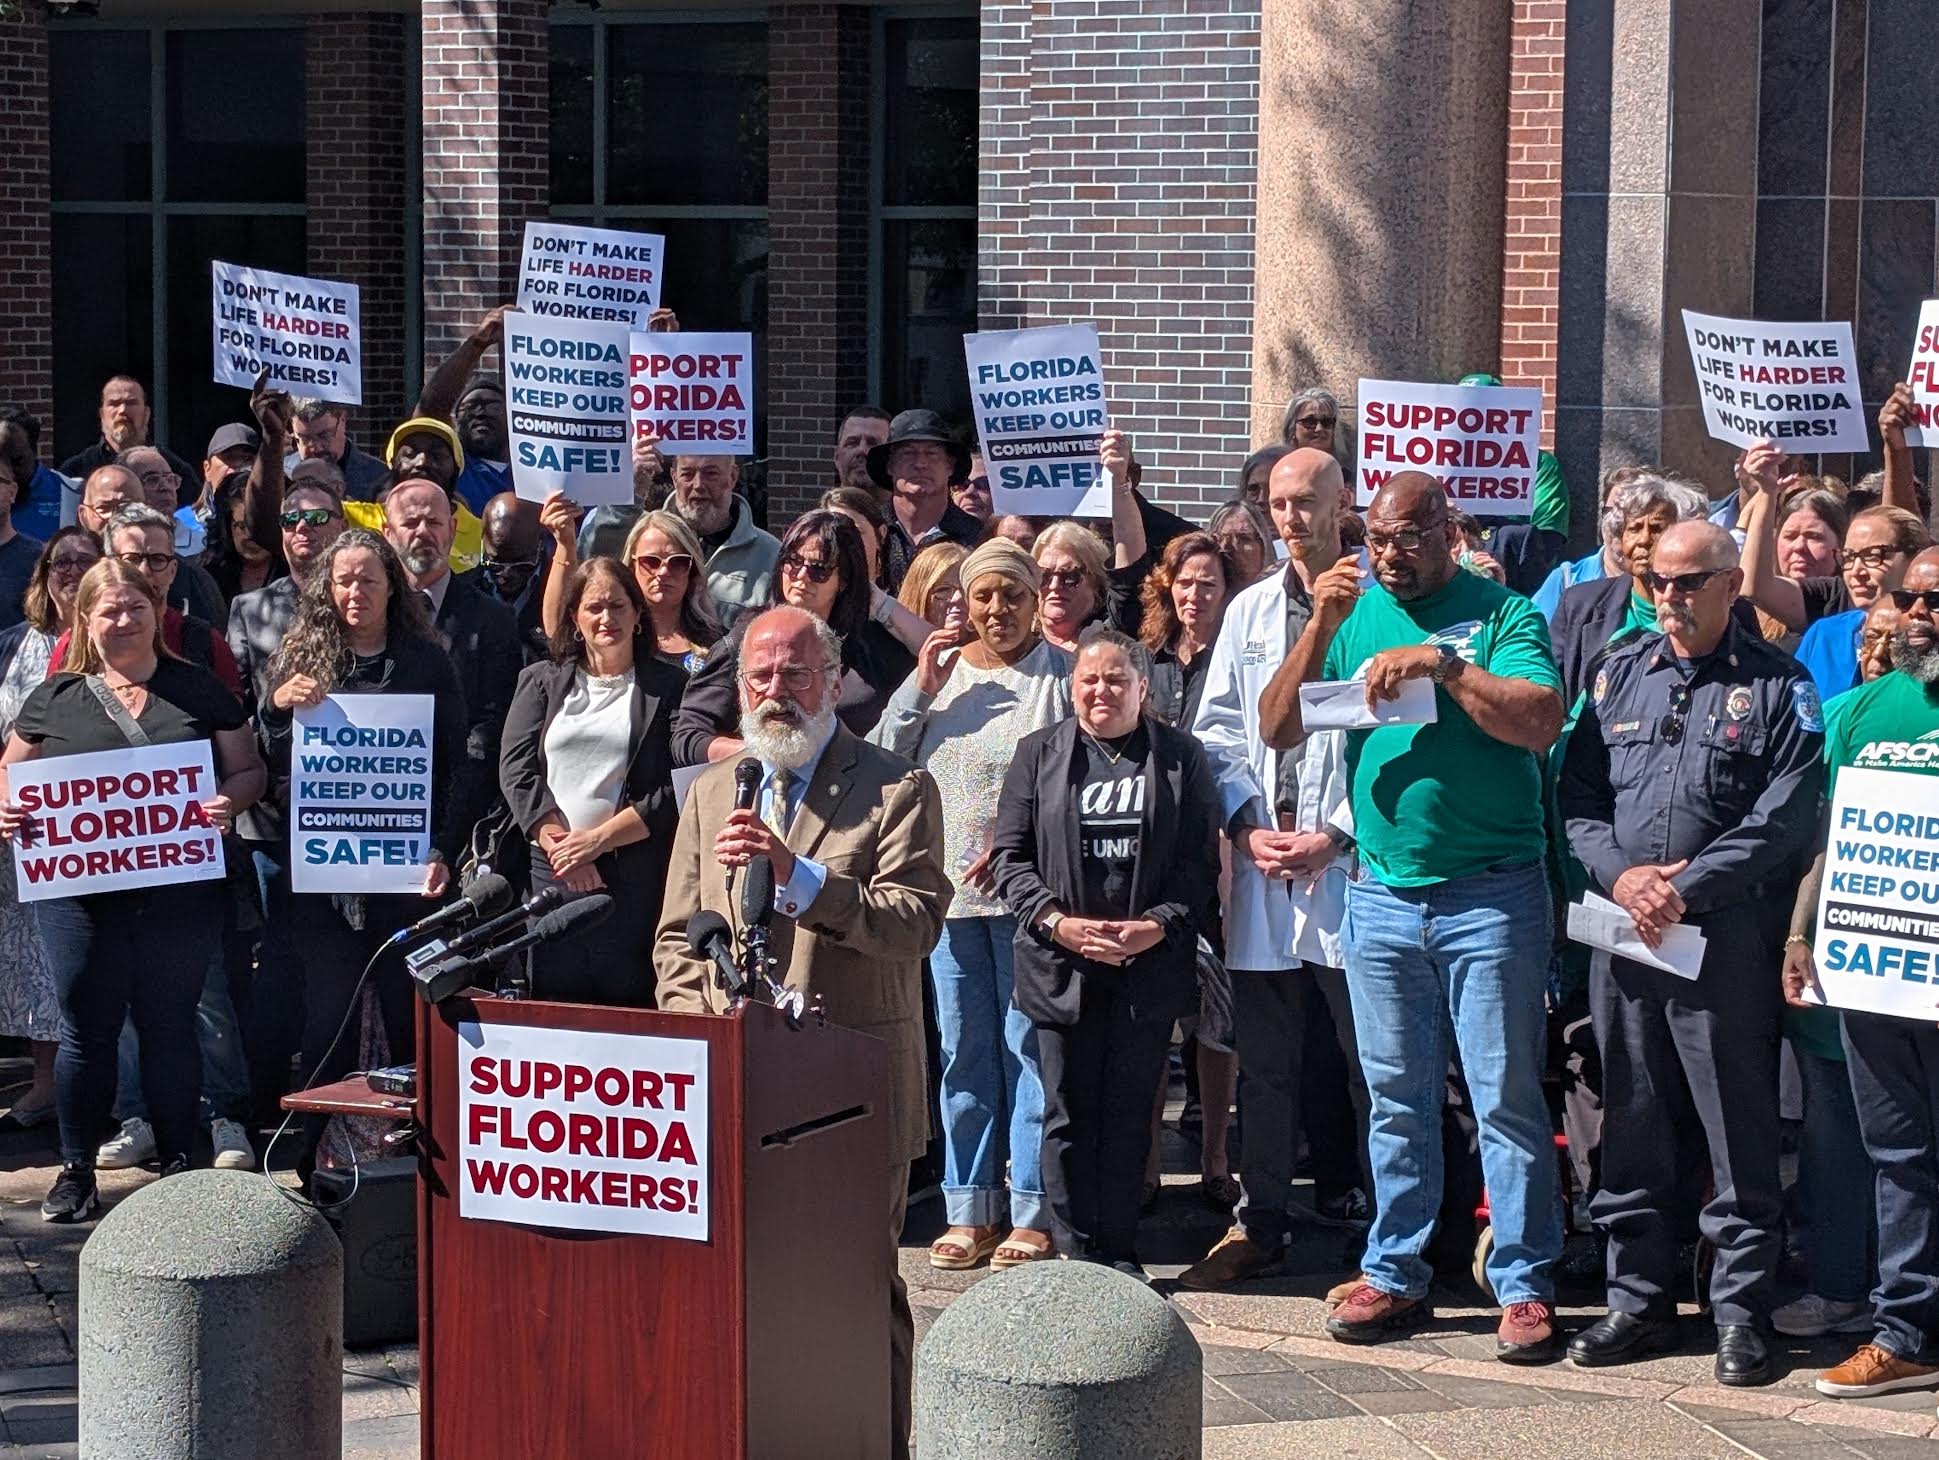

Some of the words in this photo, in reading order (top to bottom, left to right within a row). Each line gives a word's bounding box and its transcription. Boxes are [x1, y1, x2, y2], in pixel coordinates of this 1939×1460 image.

[533, 236, 587, 255] DON'T
[593, 243, 651, 262] MAKE
[528, 258, 563, 273] LIFE
[569, 262, 652, 283] HARDER
[224, 280, 279, 305] DON'T
[286, 292, 346, 315] MAKE
[524, 279, 558, 295] FOR
[564, 283, 650, 304] FLORIDA
[221, 304, 257, 326] LIFE
[263, 312, 349, 340] HARDER
[533, 301, 637, 324] WORKERS!
[220, 328, 254, 349] FOR
[260, 336, 351, 364] FLORIDA
[512, 335, 622, 363] FLORIDA
[1695, 328, 1755, 355] DON'T
[1763, 339, 1839, 357] MAKE
[231, 354, 337, 386] WORKERS!
[510, 362, 624, 388] WORKERS
[630, 355, 743, 378] PPORT
[978, 356, 1097, 384] FLORIDA
[1698, 354, 1734, 379] LIFE
[1739, 365, 1846, 384] HARDER
[512, 387, 568, 408] KEEP
[573, 394, 624, 413] OUR
[631, 385, 745, 410] ORIDA
[980, 384, 1101, 409] WORKERS
[1703, 380, 1736, 406] FOR
[1740, 391, 1851, 411] FLORIDA
[514, 416, 623, 438] COMMUNITIES
[631, 419, 746, 440] RKERS!
[984, 414, 1046, 433] KEEP
[1050, 409, 1103, 429] OUR
[1365, 402, 1532, 434] SUPPORT
[1717, 409, 1838, 438] WORKERS!
[519, 442, 620, 473] SAFE!
[1364, 433, 1530, 468] FLORIDA
[1001, 462, 1104, 489] SAFE!
[1362, 468, 1530, 499] WKERS!
[303, 727, 426, 748] FLORIDA
[300, 755, 427, 774] WORKERS
[19, 765, 203, 812] SUPPORT
[301, 781, 366, 799] KEEP
[371, 783, 425, 800] OUR
[19, 800, 212, 850] FLORIDA
[302, 813, 423, 827] COMMUNITIES
[22, 839, 216, 884] WORKERS!
[305, 838, 419, 865] SAFE!
[1830, 871, 1896, 898] KEEP
[469, 1057, 695, 1111] SUPPORT
[469, 1104, 698, 1165] FLORIDA
[467, 1159, 698, 1214] WORKERS!
